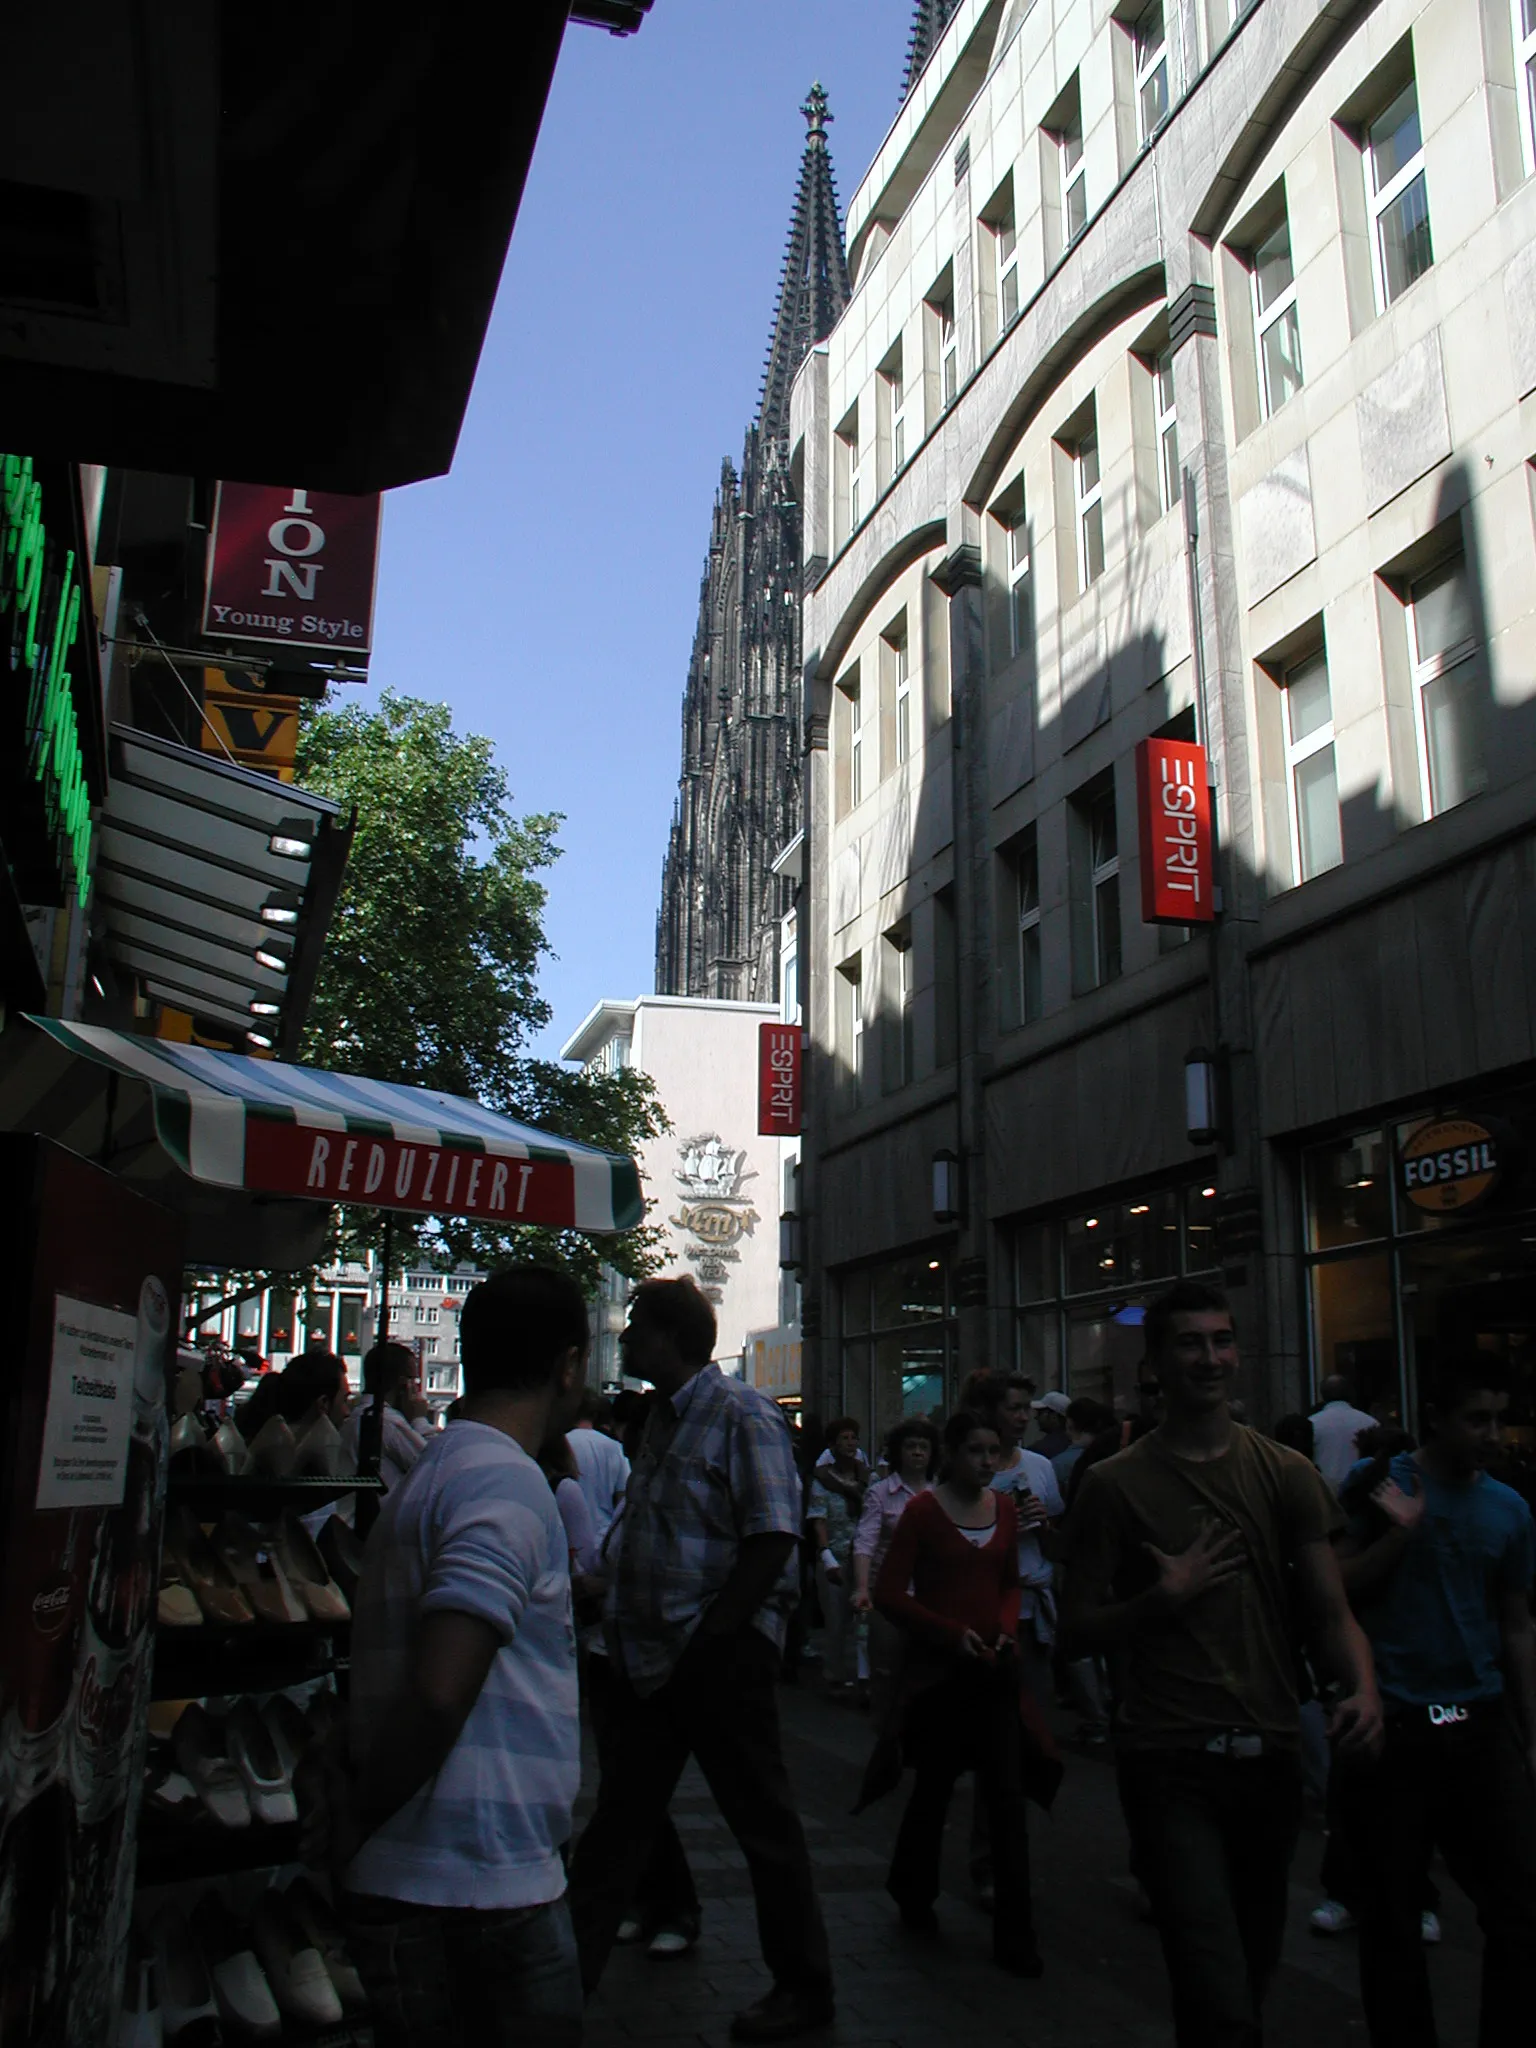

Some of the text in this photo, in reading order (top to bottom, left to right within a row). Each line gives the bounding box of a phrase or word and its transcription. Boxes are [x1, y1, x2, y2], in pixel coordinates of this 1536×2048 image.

[212, 604, 364, 640] Young Style
[1161, 757, 1200, 903] ESPRIT
[770, 1033, 794, 1124] ESPRIT
[306, 1135, 534, 1214] REDUZIERT
[1403, 1143, 1498, 1188] FOSSIL
